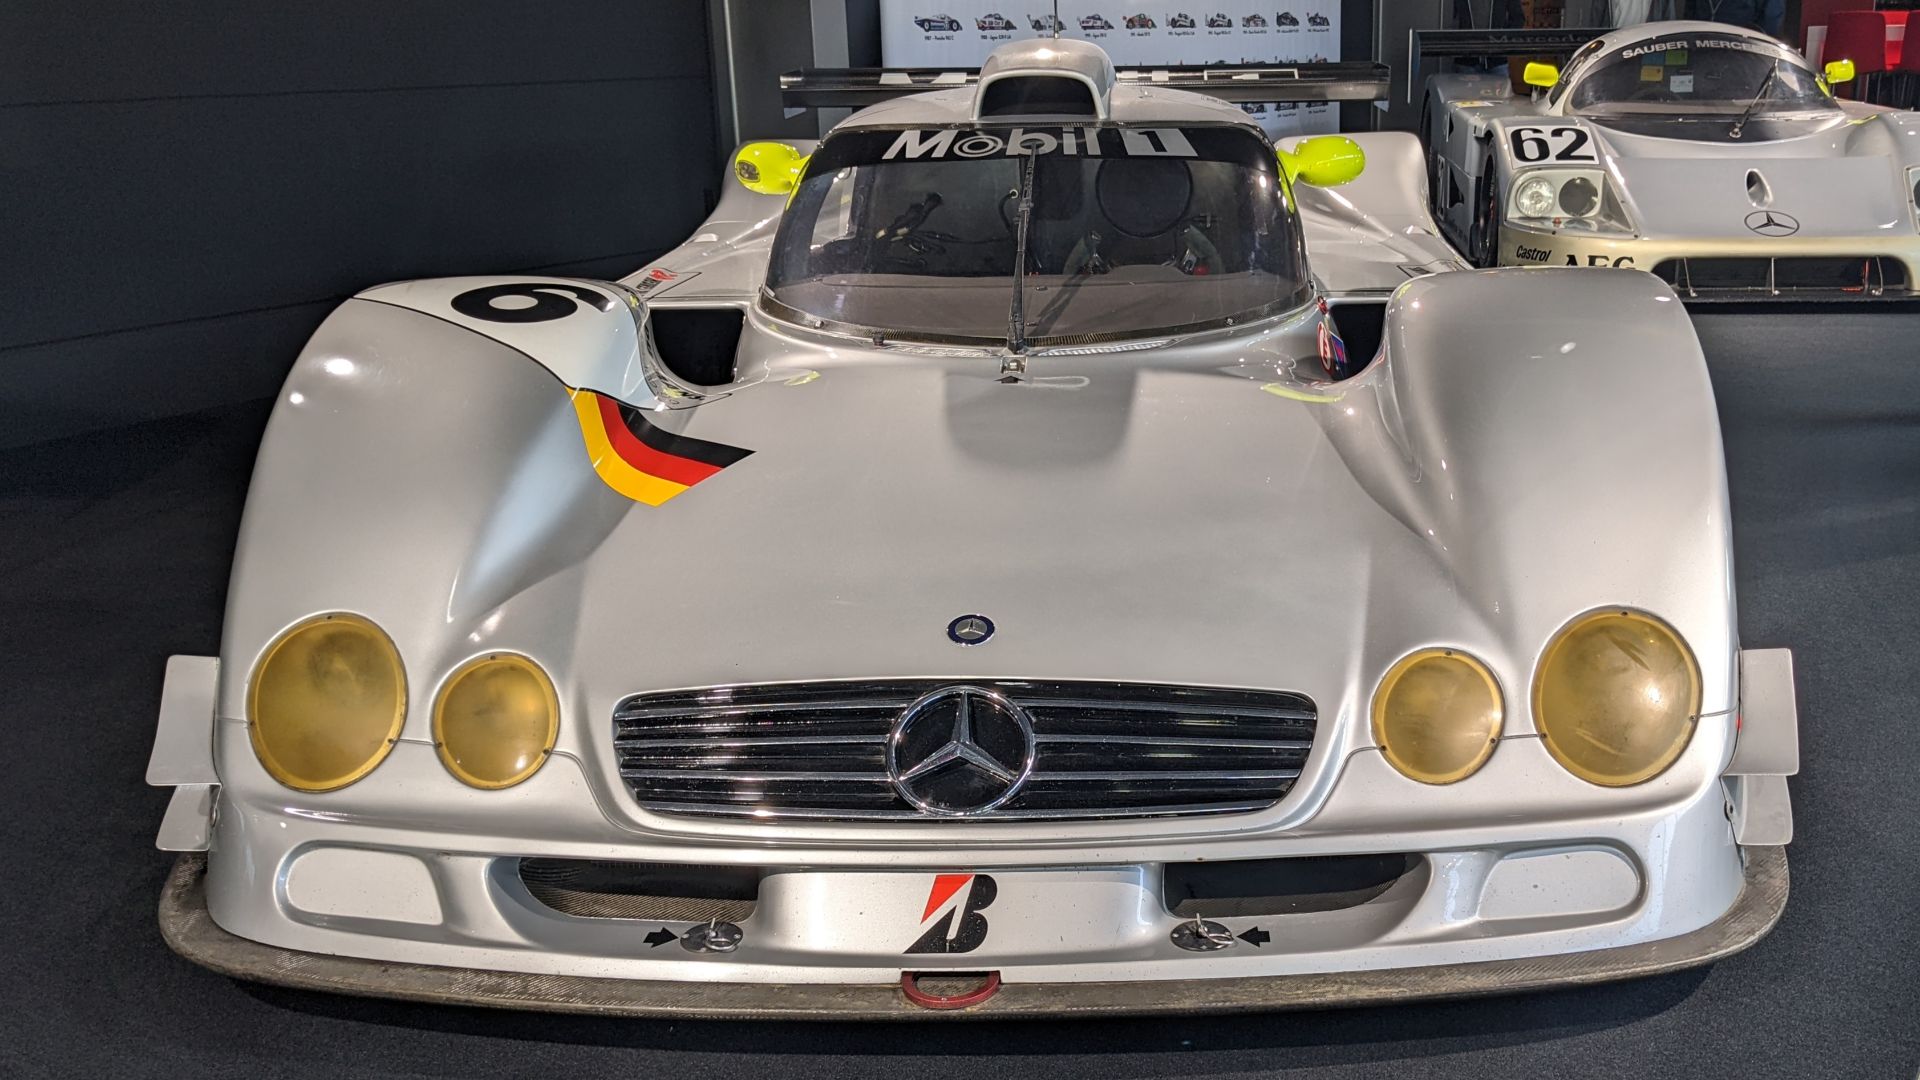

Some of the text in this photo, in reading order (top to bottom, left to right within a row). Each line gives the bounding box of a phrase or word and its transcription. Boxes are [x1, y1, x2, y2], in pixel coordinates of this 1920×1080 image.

[1487, 34, 1595, 43] Mercede
[1622, 40, 1689, 59] SAUBER
[881, 127, 1103, 159] Mobil
[1510, 127, 1596, 162] 62
[1515, 244, 1552, 262] Castrol
